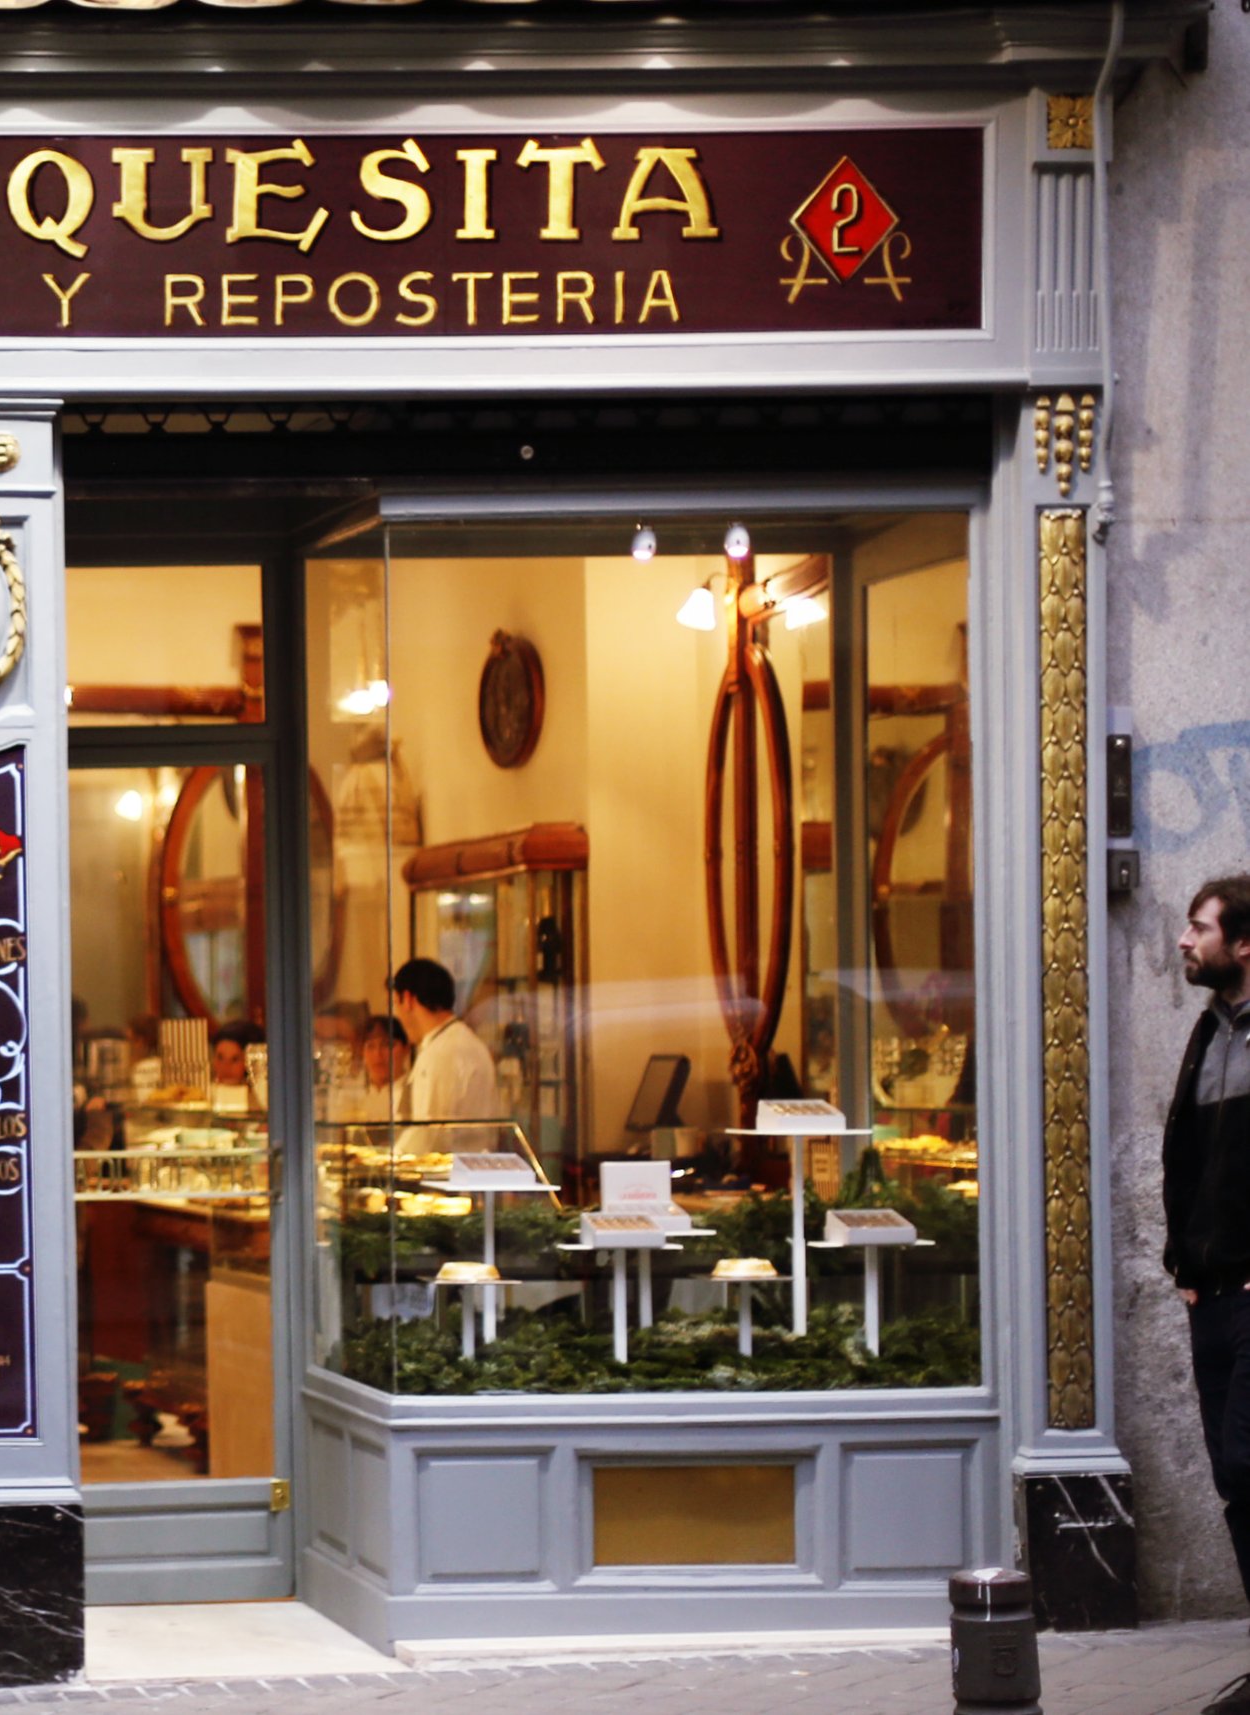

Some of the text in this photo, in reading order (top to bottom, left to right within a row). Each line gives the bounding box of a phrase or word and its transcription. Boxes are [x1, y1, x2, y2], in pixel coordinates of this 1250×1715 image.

[830, 183, 861, 254] 2
[40, 271, 93, 329] Y
[163, 268, 681, 328] REPOSTERIA
